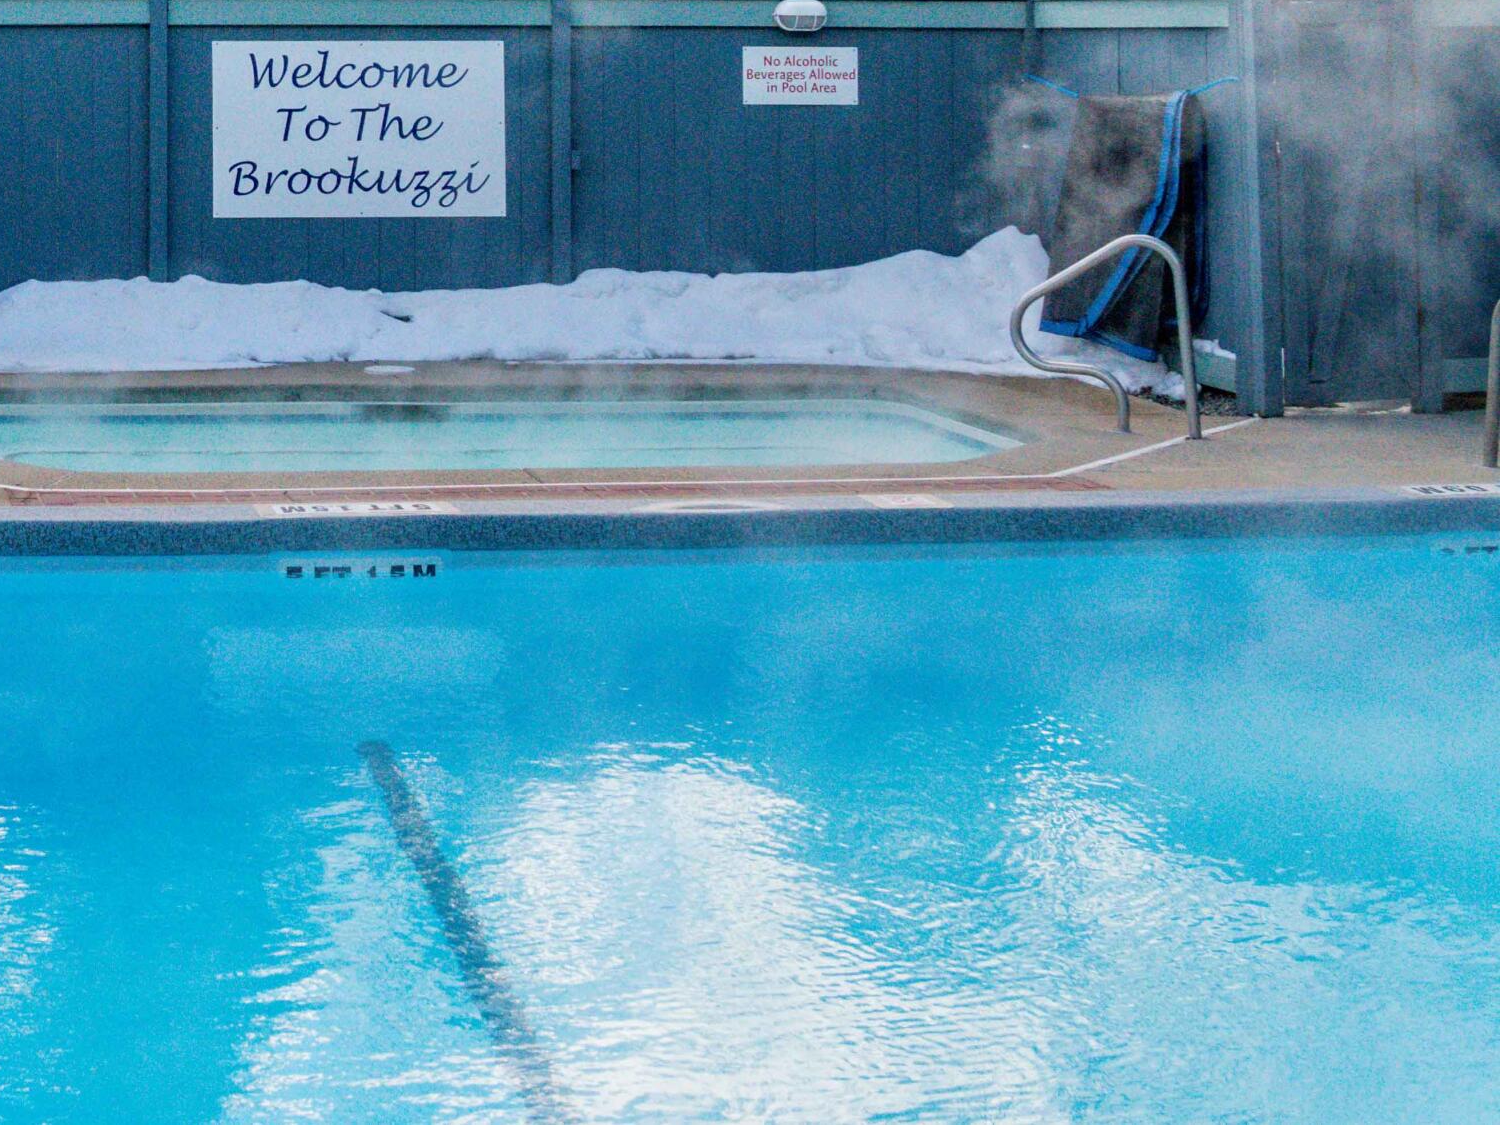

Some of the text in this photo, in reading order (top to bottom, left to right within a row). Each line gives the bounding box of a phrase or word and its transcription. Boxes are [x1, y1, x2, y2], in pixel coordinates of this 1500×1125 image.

[249, 50, 469, 89] Welcome
[763, 55, 839, 67] No Alcoholic
[746, 68, 856, 82] Beverages Allowed
[766, 81, 837, 93] in Pool Area
[277, 103, 444, 142] To The
[228, 156, 490, 208] Brookuzzi
